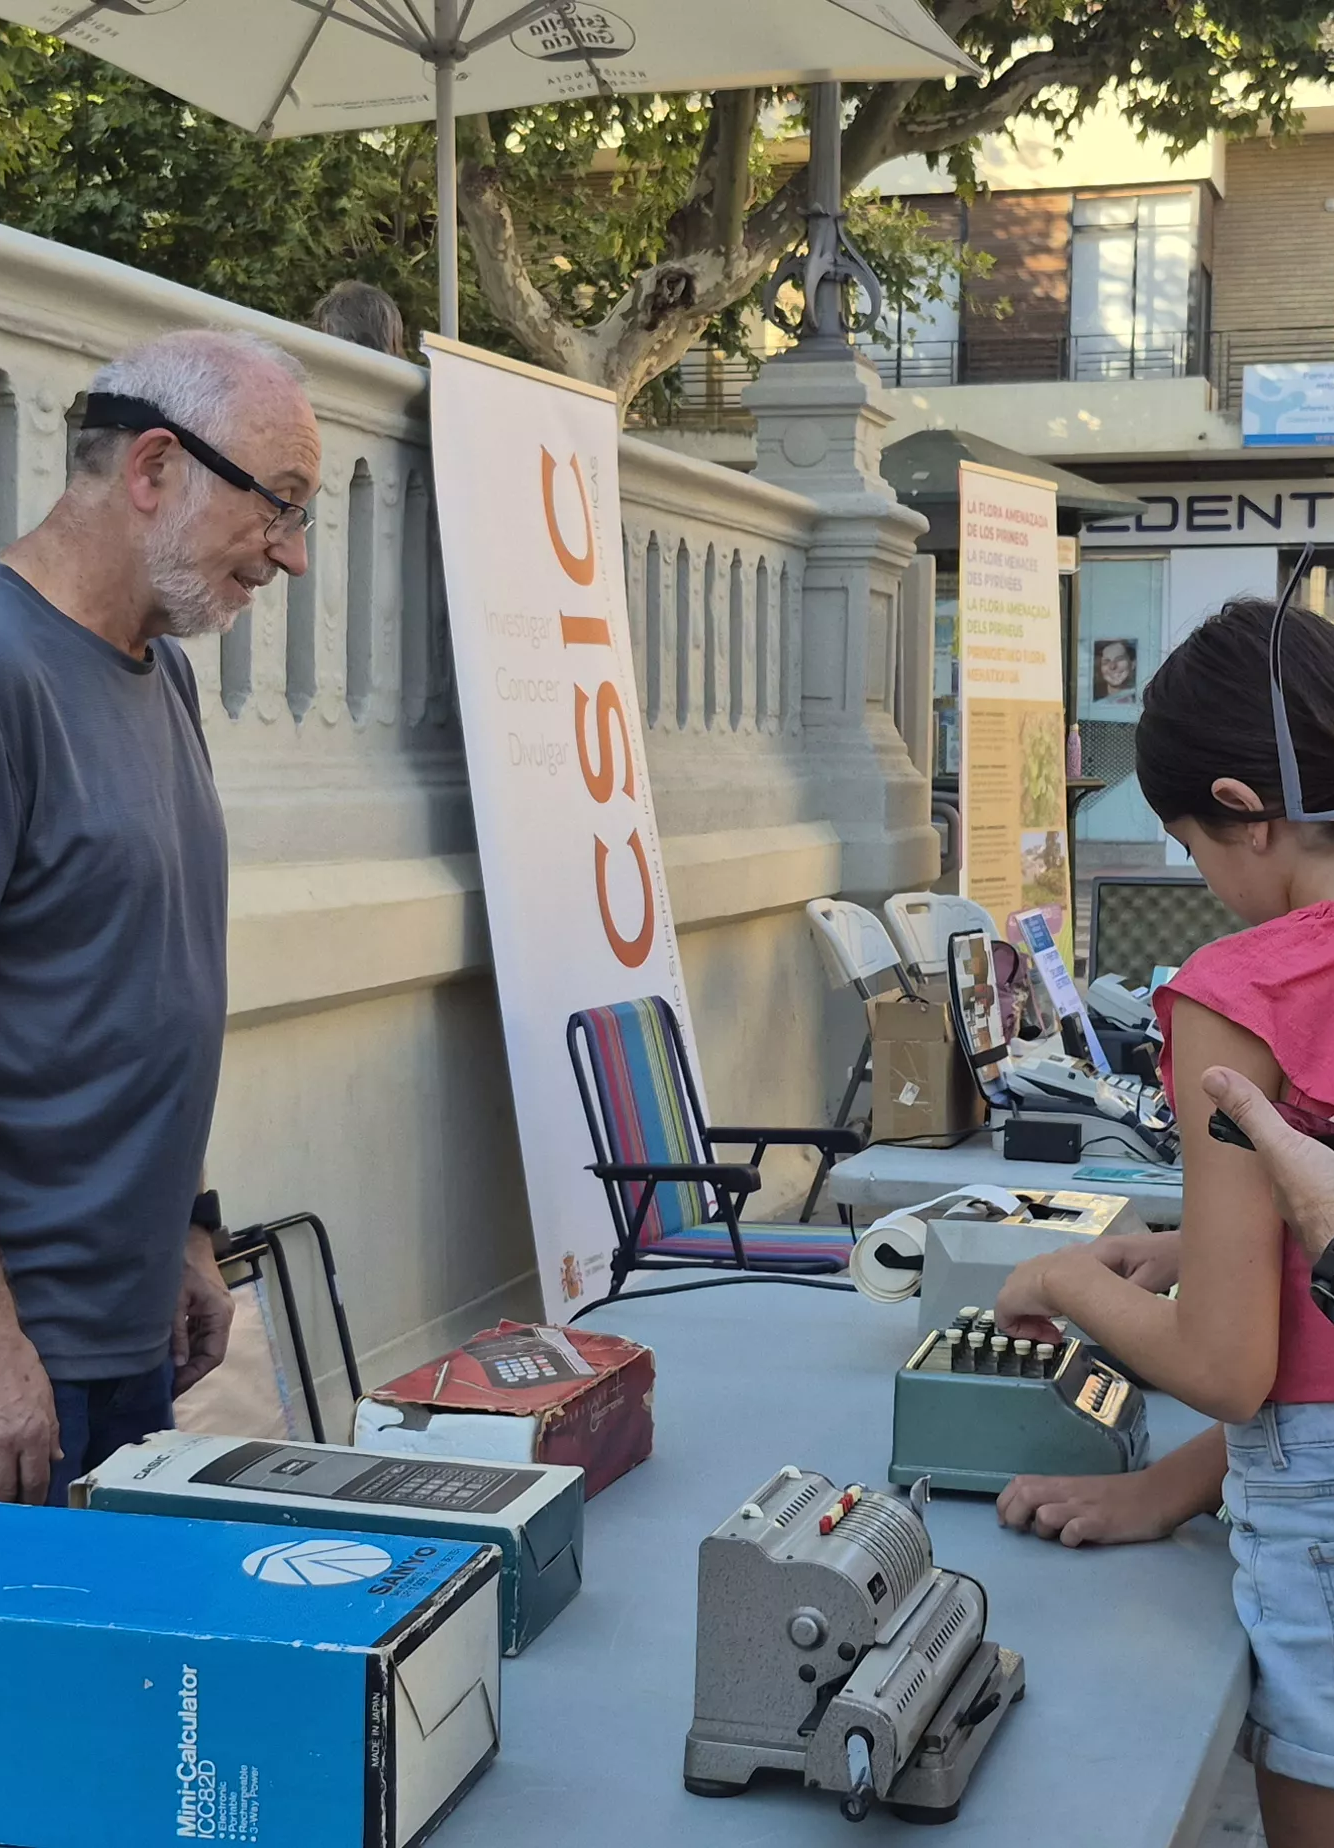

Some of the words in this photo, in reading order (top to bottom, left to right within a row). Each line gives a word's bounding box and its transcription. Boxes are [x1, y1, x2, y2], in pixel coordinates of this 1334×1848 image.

[967, 522, 978, 538] DE
[979, 525, 994, 541] LOS
[483, 599, 552, 649] Investigar
[495, 666, 562, 703] Conocer
[540, 443, 655, 968] CSIC
[508, 731, 570, 777] Divulgar
[367, 1546, 437, 1595] SANYO
[371, 1692, 381, 1723] JAPAN
[176, 1663, 198, 1838] Mini-Calculator
[371, 1725, 380, 1736] IN
[371, 1739, 380, 1767] MADE
[197, 1759, 216, 1839] ICC82D
[239, 1764, 249, 1833] Rechargeable
[250, 1766, 259, 1798] Power
[218, 1781, 228, 1831] Electronic
[229, 1791, 238, 1832] Portable
[250, 1801, 259, 1834] 3-Way
